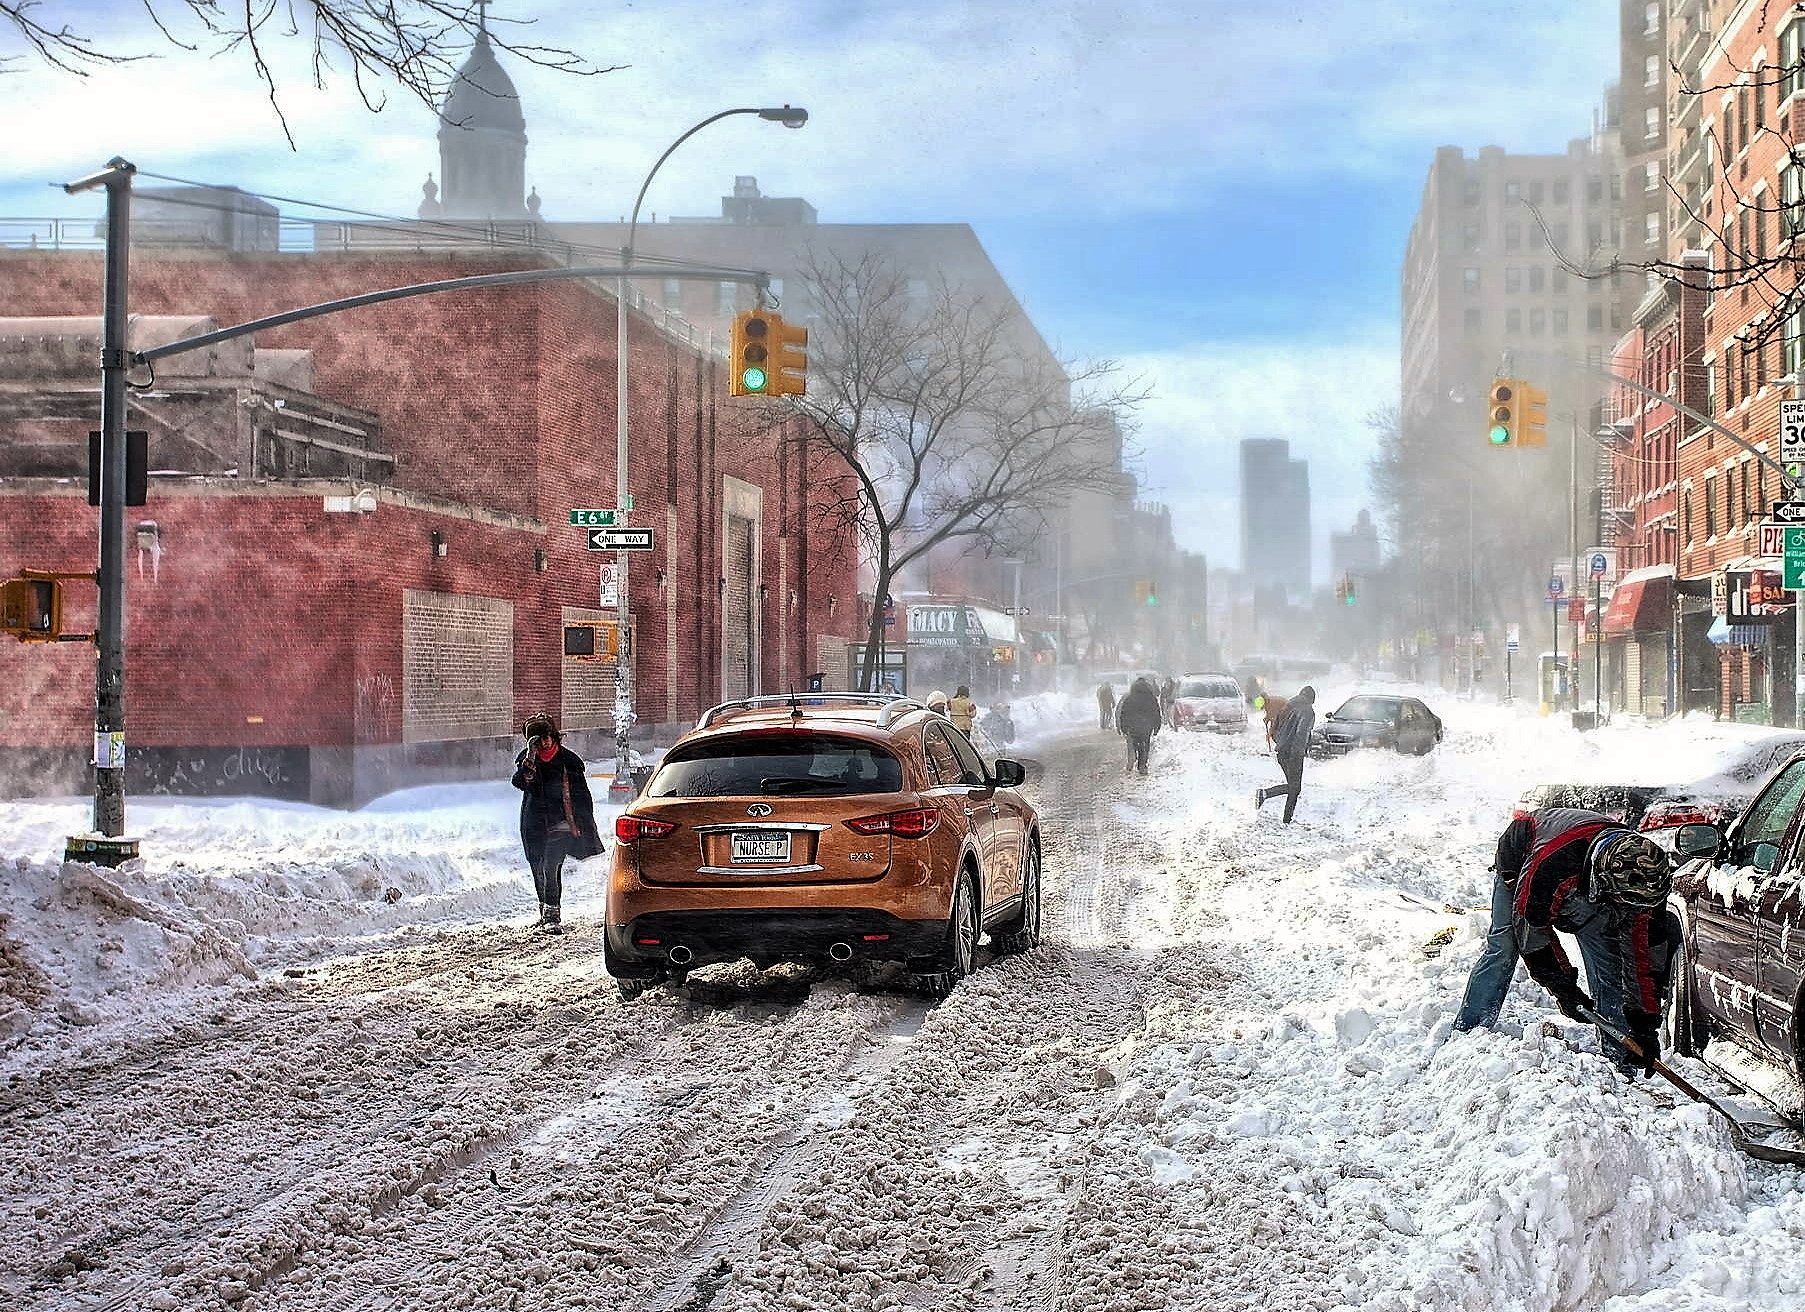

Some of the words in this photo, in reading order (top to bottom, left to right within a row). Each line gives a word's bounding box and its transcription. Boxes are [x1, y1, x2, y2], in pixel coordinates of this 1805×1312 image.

[1783, 405, 1805, 413] SPE
[1783, 508, 1800, 517] ONE
[577, 511, 585, 524] E
[588, 512, 598, 524] 6
[624, 535, 644, 543] WAY
[740, 841, 770, 855] NURSE
[776, 841, 783, 856] P
